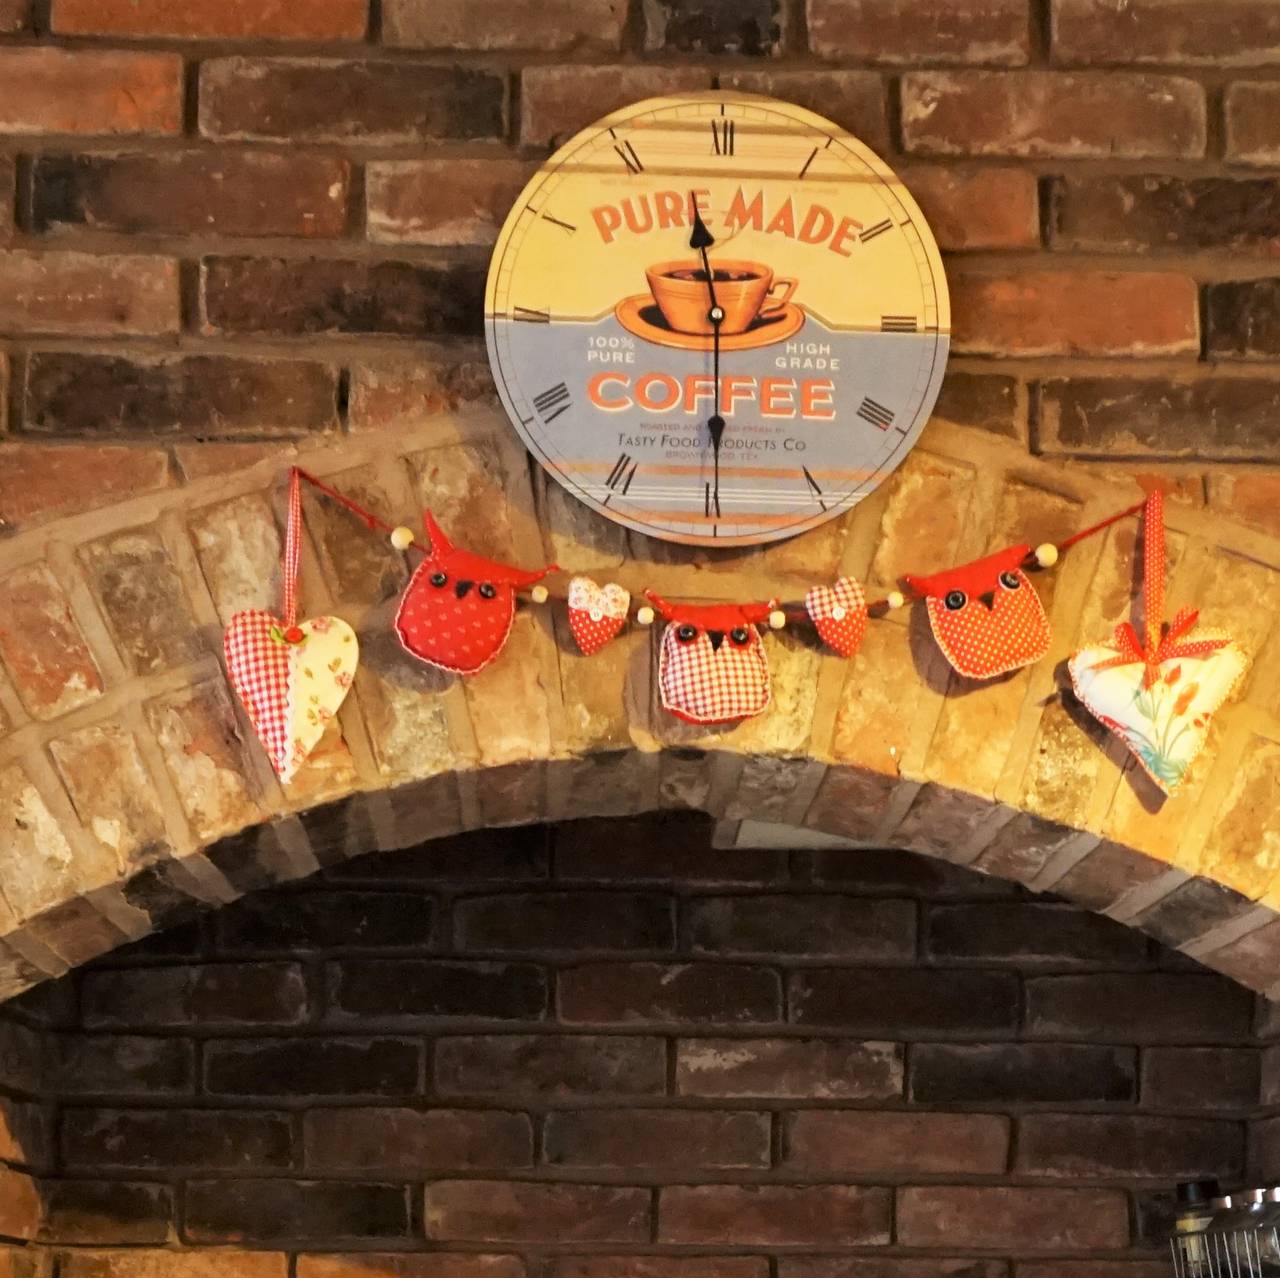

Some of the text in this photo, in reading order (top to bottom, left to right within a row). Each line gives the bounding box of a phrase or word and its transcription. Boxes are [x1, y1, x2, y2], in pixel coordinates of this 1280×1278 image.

[591, 184, 864, 258] PURE MADE
[587, 335, 635, 350] 100%
[785, 343, 831, 356] HIGH
[586, 350, 635, 363] PURE
[775, 356, 841, 370] GRADE
[586, 370, 837, 420] COFFEE
[617, 432, 657, 447] TASTY
[660, 434, 701, 448] FOOD
